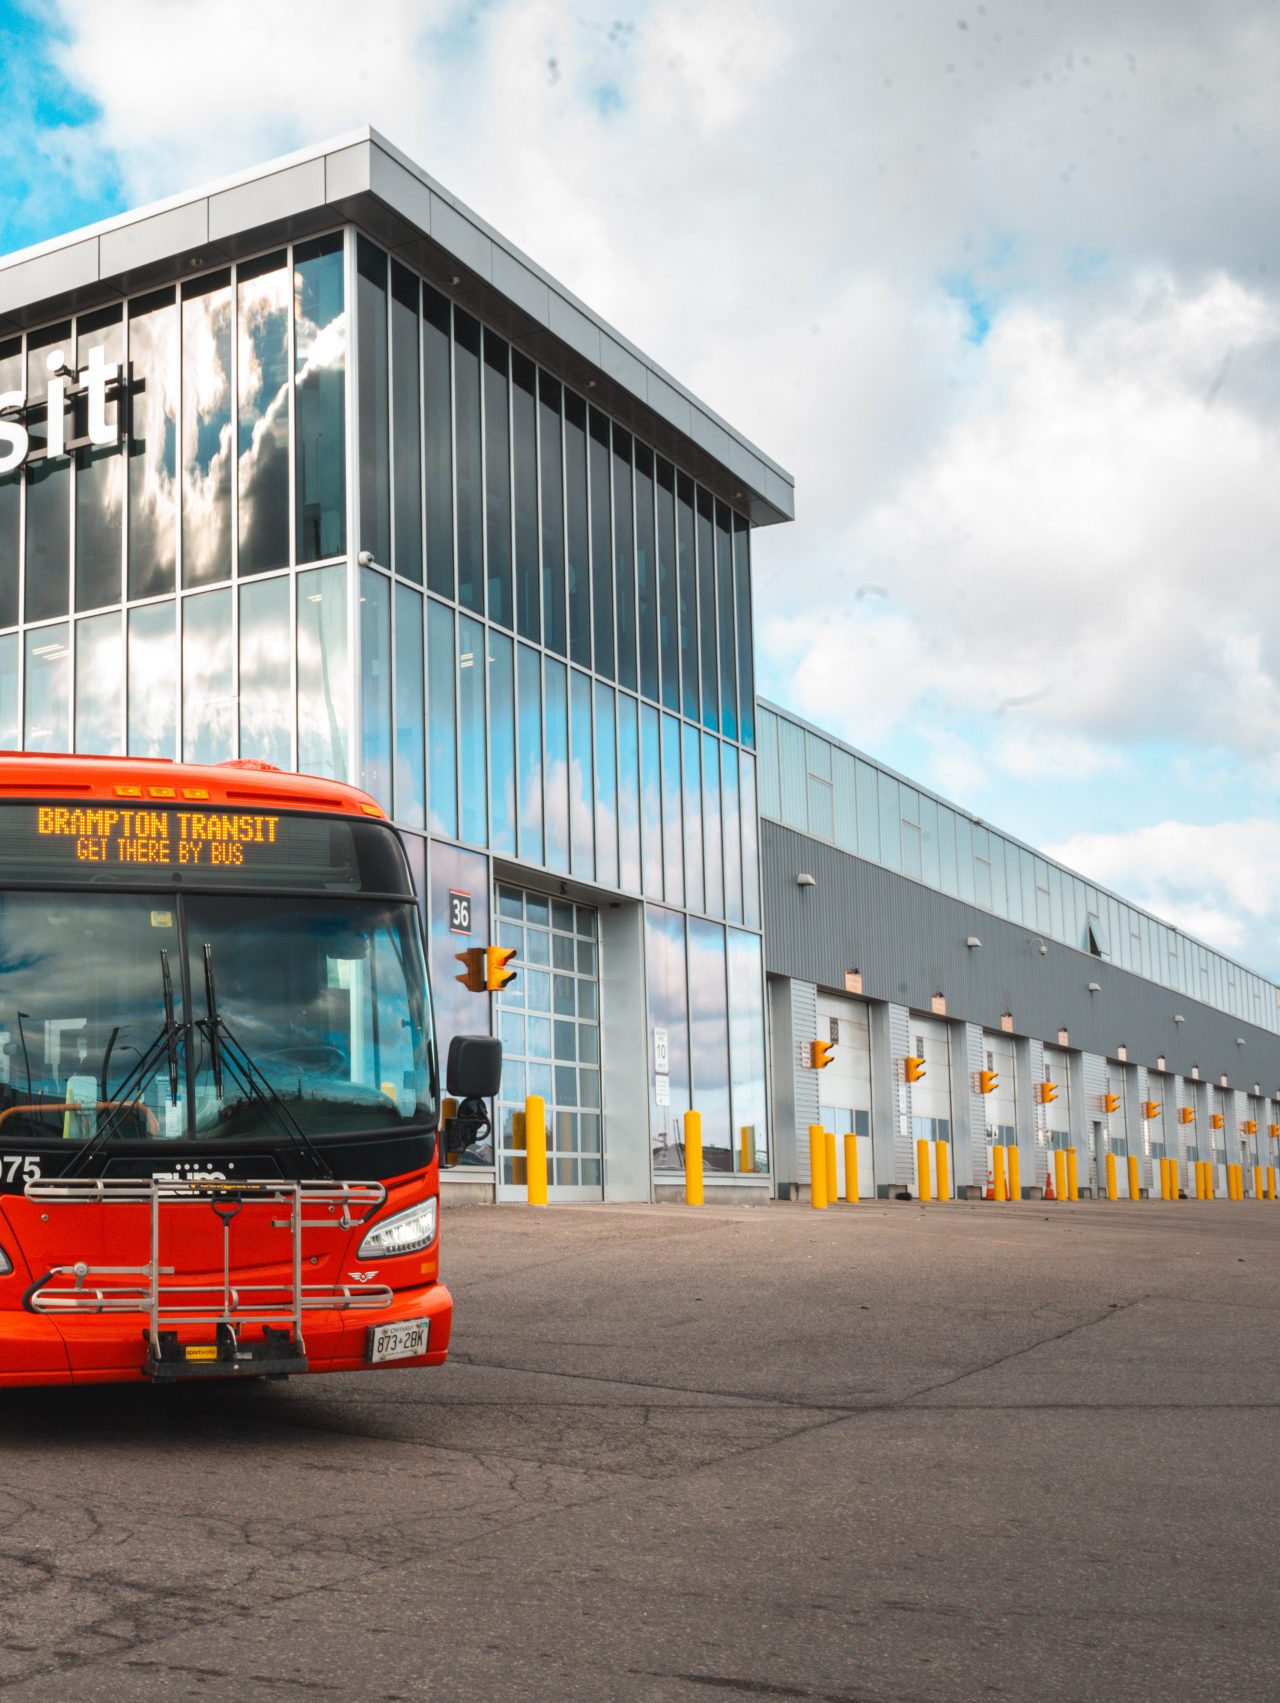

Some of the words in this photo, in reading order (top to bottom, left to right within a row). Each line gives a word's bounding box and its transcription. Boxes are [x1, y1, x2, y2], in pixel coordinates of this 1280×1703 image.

[38, 807, 168, 838] BRAMPTON
[177, 813, 279, 842] TRANSIT
[77, 838, 108, 861] GET
[118, 838, 170, 863] THERE
[179, 841, 202, 864] BY
[211, 842, 244, 865] BUS
[453, 899, 469, 927] 36
[657, 1044, 666, 1060] 10
[390, 1325, 414, 1335] ONTARIO
